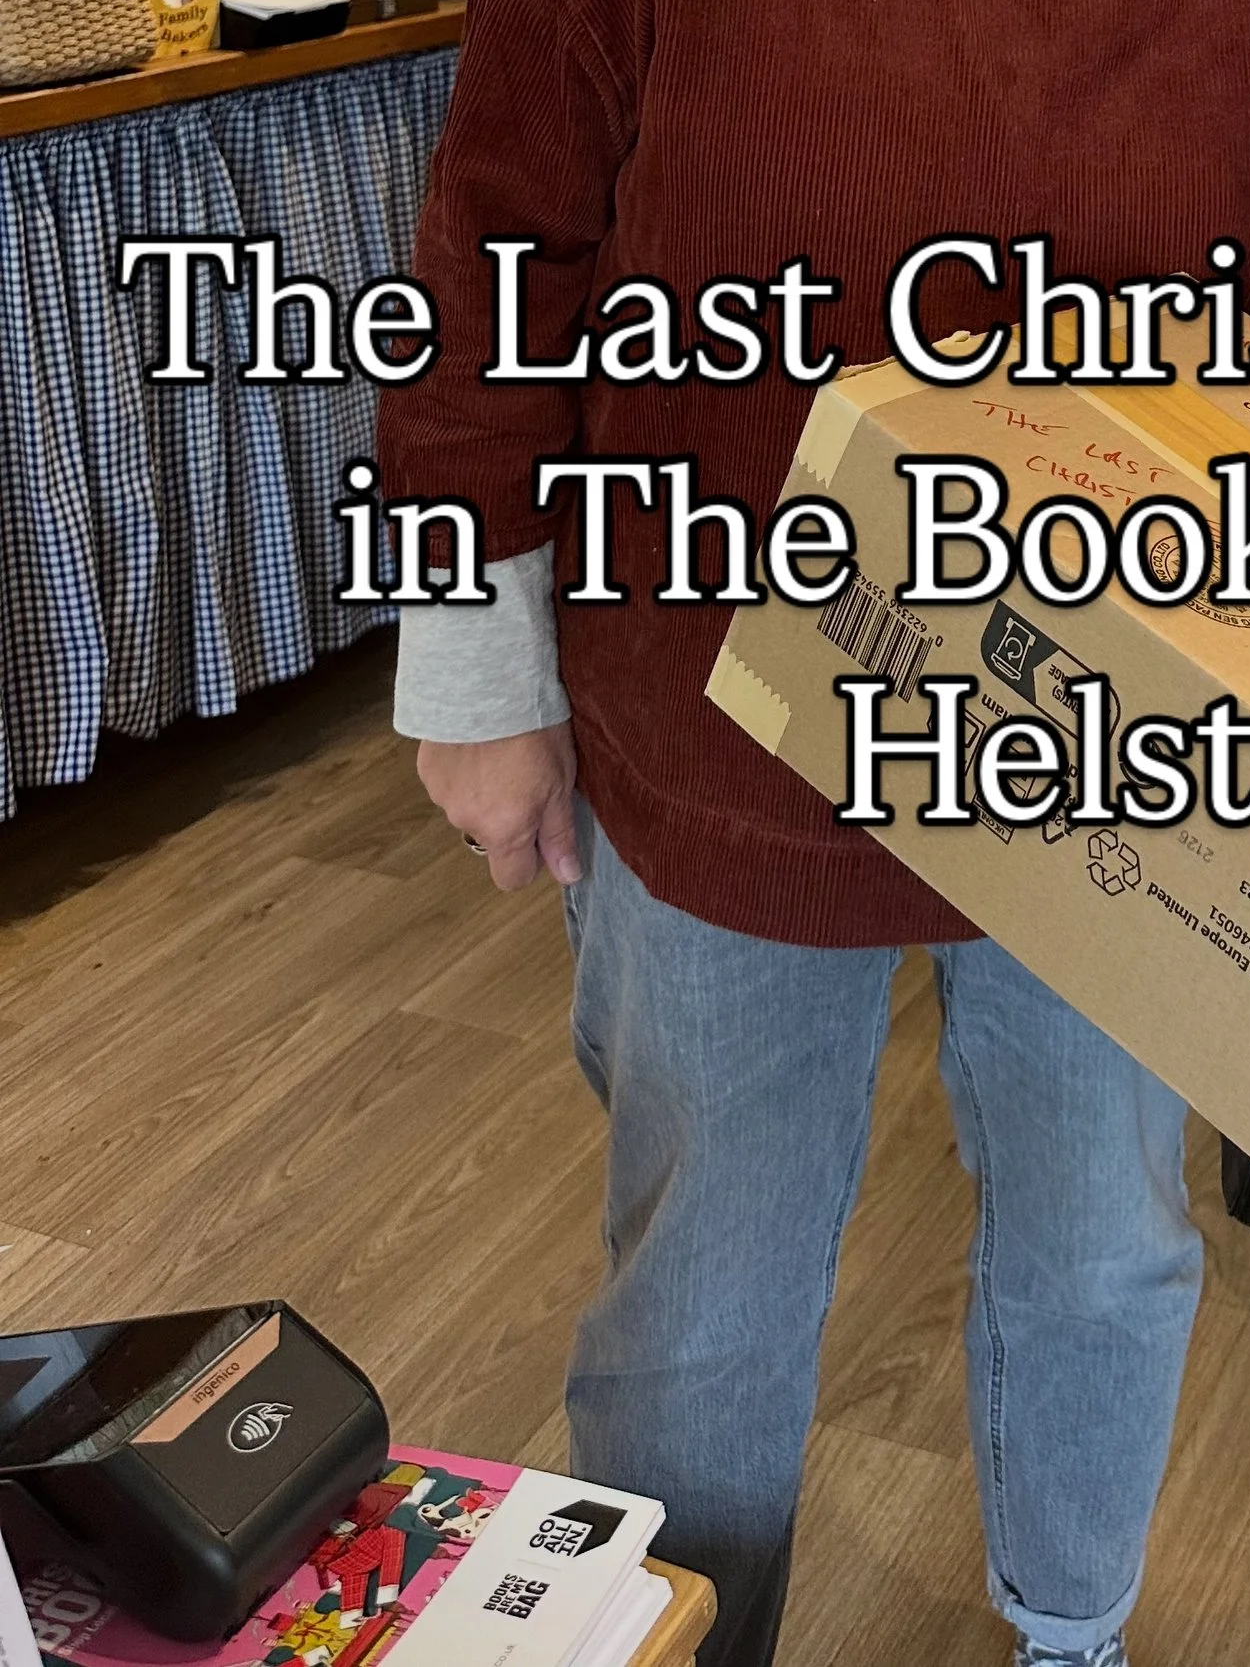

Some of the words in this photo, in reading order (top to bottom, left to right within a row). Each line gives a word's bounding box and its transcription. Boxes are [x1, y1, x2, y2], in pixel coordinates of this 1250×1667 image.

[159, 5, 208, 27] Family
[1085, 443, 1176, 483] LAST
[888, 598, 929, 634] 622356
[934, 635, 944, 648] 0
[1146, 882, 1200, 932] Limited
[1200, 923, 1250, 973] Europe
[192, 1362, 240, 1404] ingenico
[529, 1519, 556, 1548] GO
[543, 1523, 572, 1554] ALL
[556, 1526, 587, 1557] IN.
[482, 1573, 518, 1611] BOOKS
[496, 1594, 517, 1614] ARE
[510, 1577, 528, 1595] MY
[506, 1580, 551, 1620] BAG
